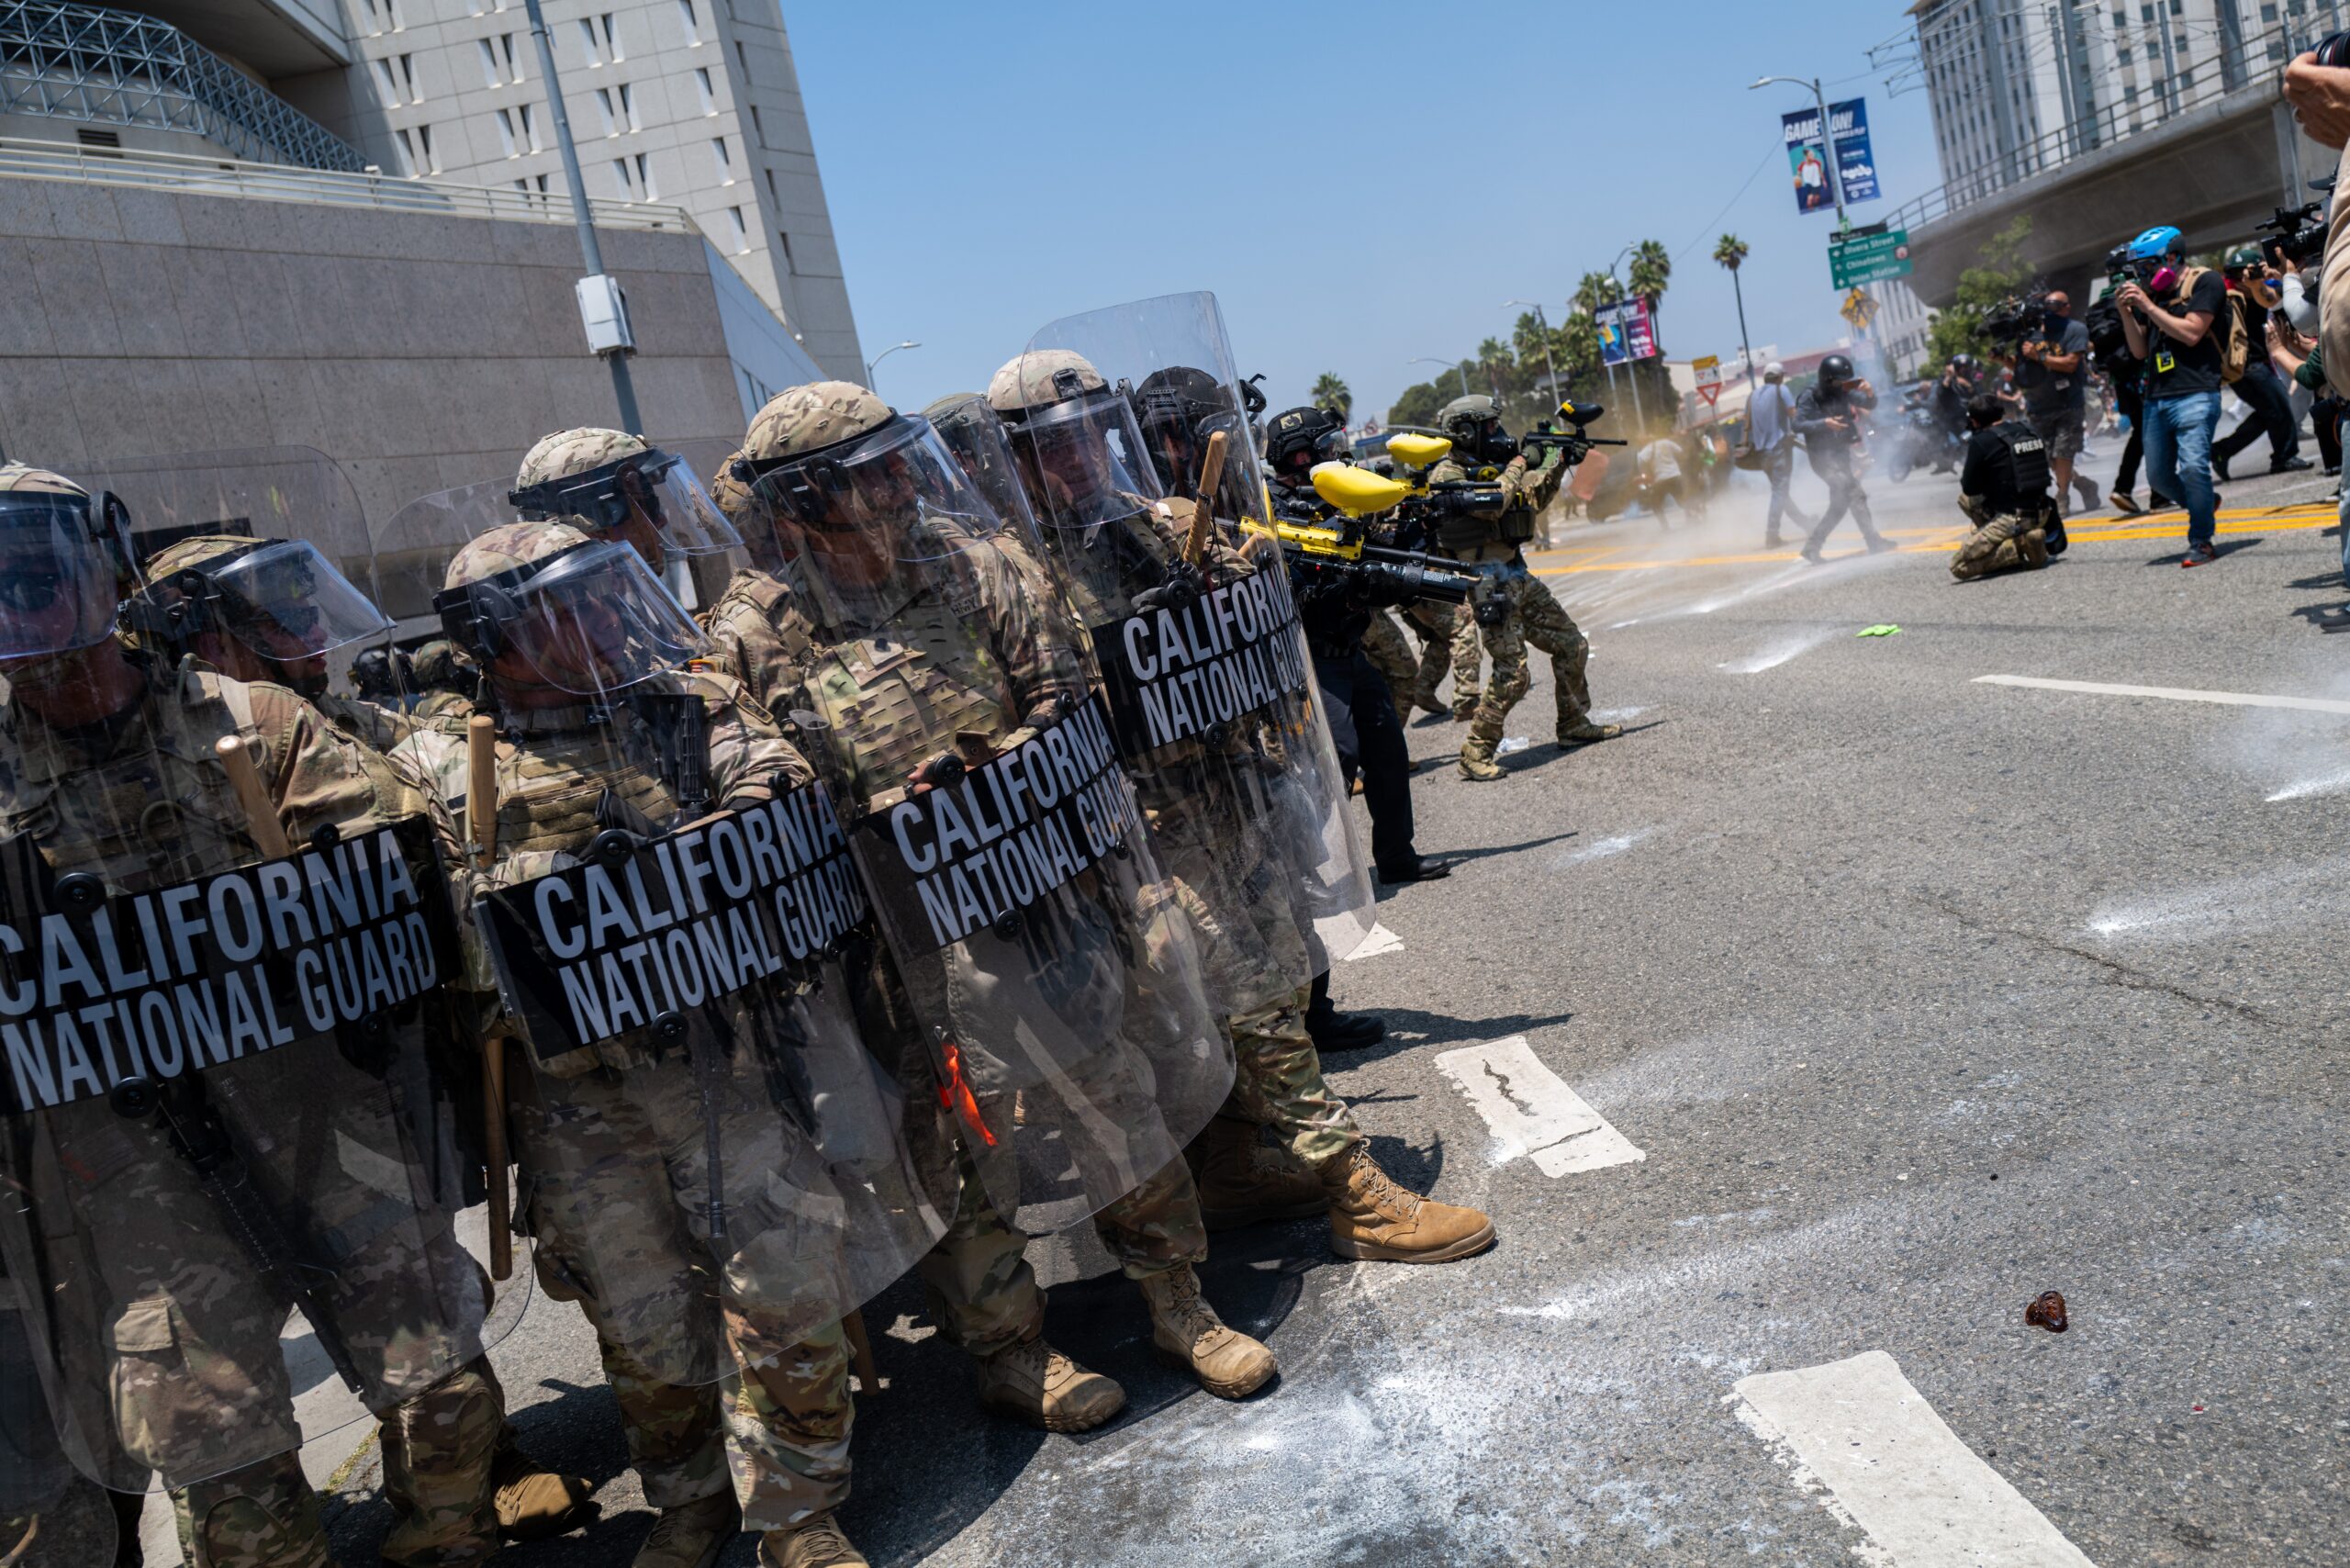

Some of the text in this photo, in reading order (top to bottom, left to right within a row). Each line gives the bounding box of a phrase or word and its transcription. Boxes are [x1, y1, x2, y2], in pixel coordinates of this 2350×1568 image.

[1785, 118, 1821, 142] GAME
[1831, 111, 1852, 132] ON!
[1843, 236, 1895, 255] Olvera Street
[1846, 255, 1886, 270] Chinatown
[1848, 266, 1900, 285] Union Station
[2014, 439, 2043, 454] PRESS
[1138, 643, 1278, 747] NATIONAL
[890, 697, 1115, 873] CALIFORNIA
[916, 759, 1139, 946] NATIONAL GUARD
[0, 828, 420, 1016] CALIFORNIA
[533, 779, 845, 959] CALIFORNIA
[2, 911, 437, 1112] NATIONAL GUARD
[558, 852, 865, 1045] NATIONAL GUARD
